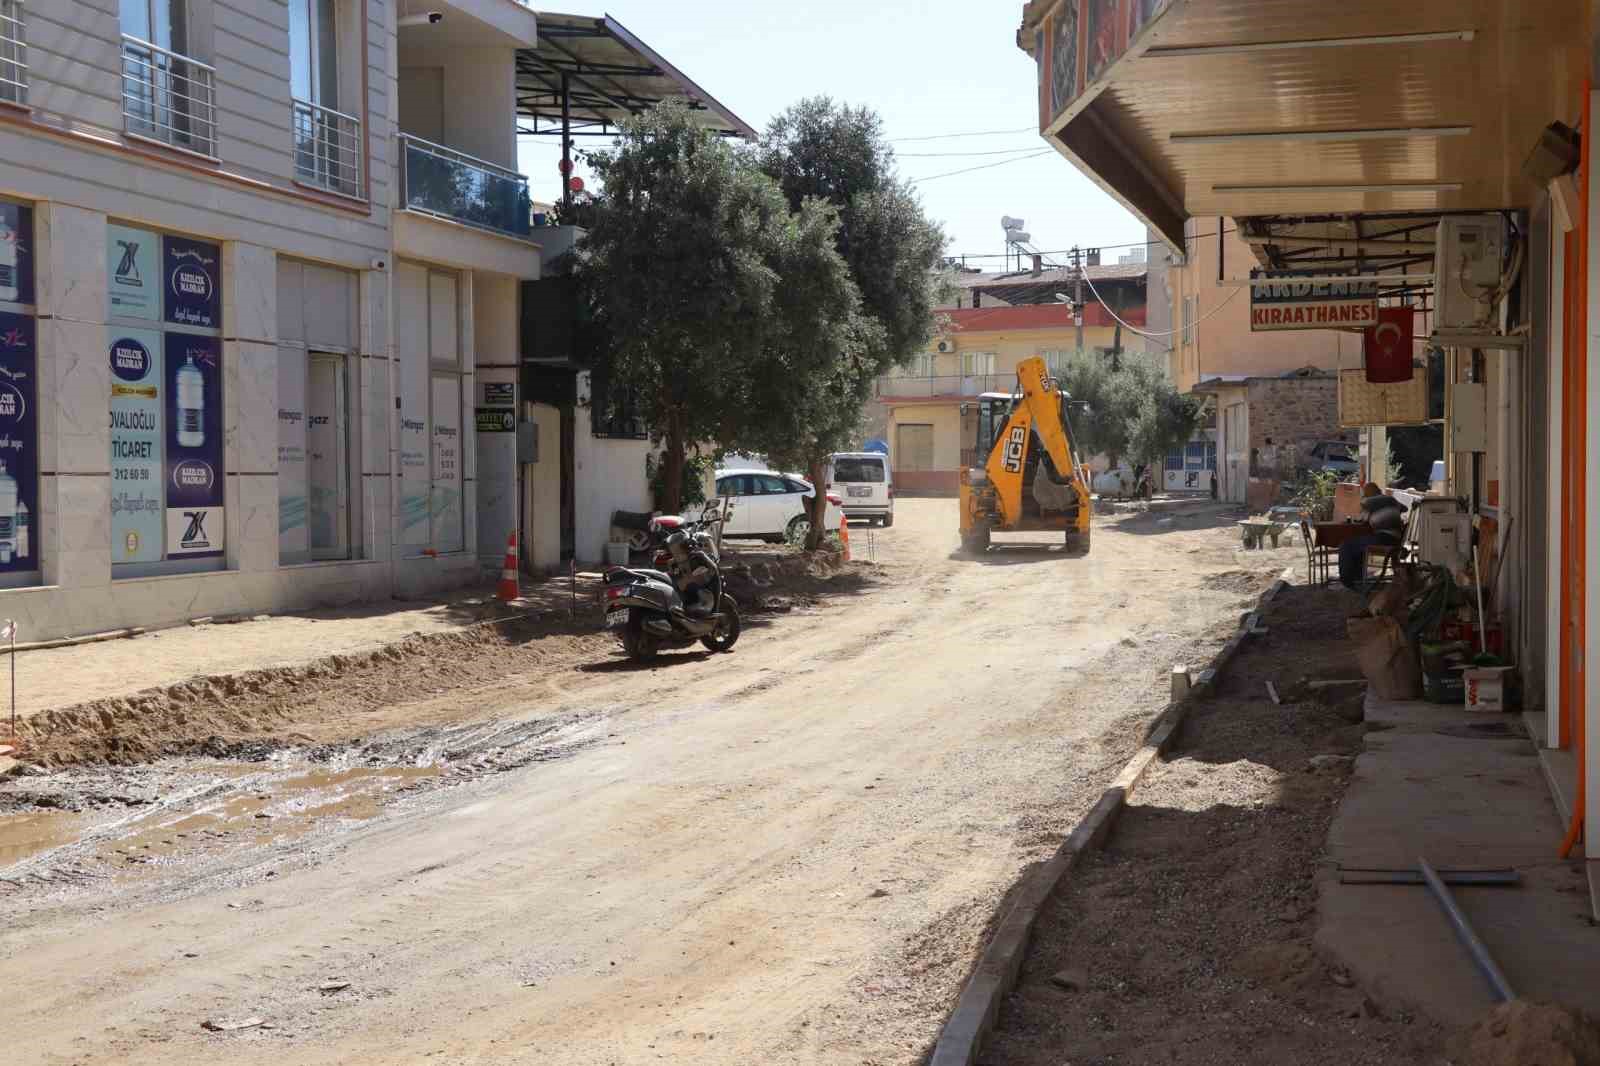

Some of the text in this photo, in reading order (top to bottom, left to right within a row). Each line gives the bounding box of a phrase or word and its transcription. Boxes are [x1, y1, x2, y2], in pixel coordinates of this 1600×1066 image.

[1253, 302, 1376, 325] KIRAATHANESİ
[112, 436, 152, 458] TİCARET
[1007, 427, 1025, 473] JCB
